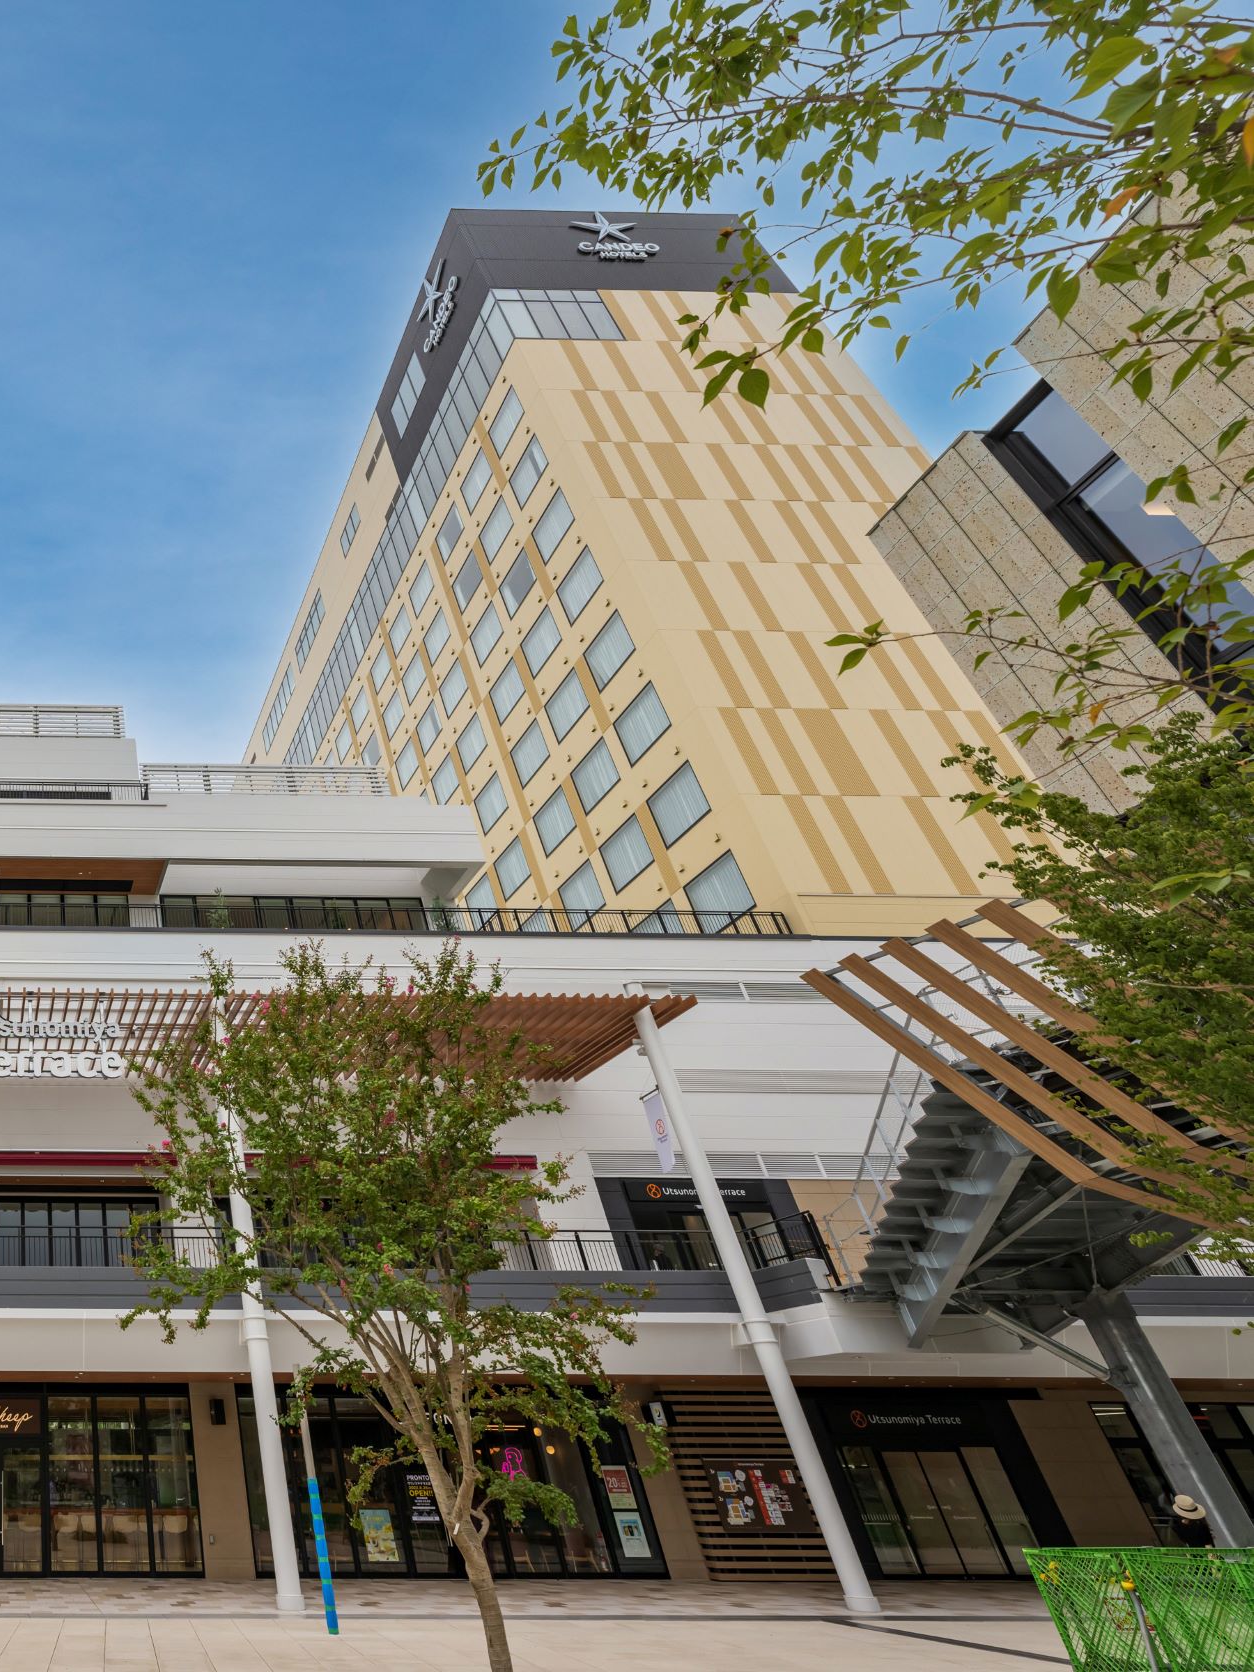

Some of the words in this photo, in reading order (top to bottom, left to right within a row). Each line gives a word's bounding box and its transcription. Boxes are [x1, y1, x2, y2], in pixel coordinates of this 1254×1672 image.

[577, 241, 661, 253] CANDEO
[599, 251, 648, 260] HOTELS
[867, 1414, 925, 1426] Utsunomiya
[925, 1414, 962, 1425] Terrace
